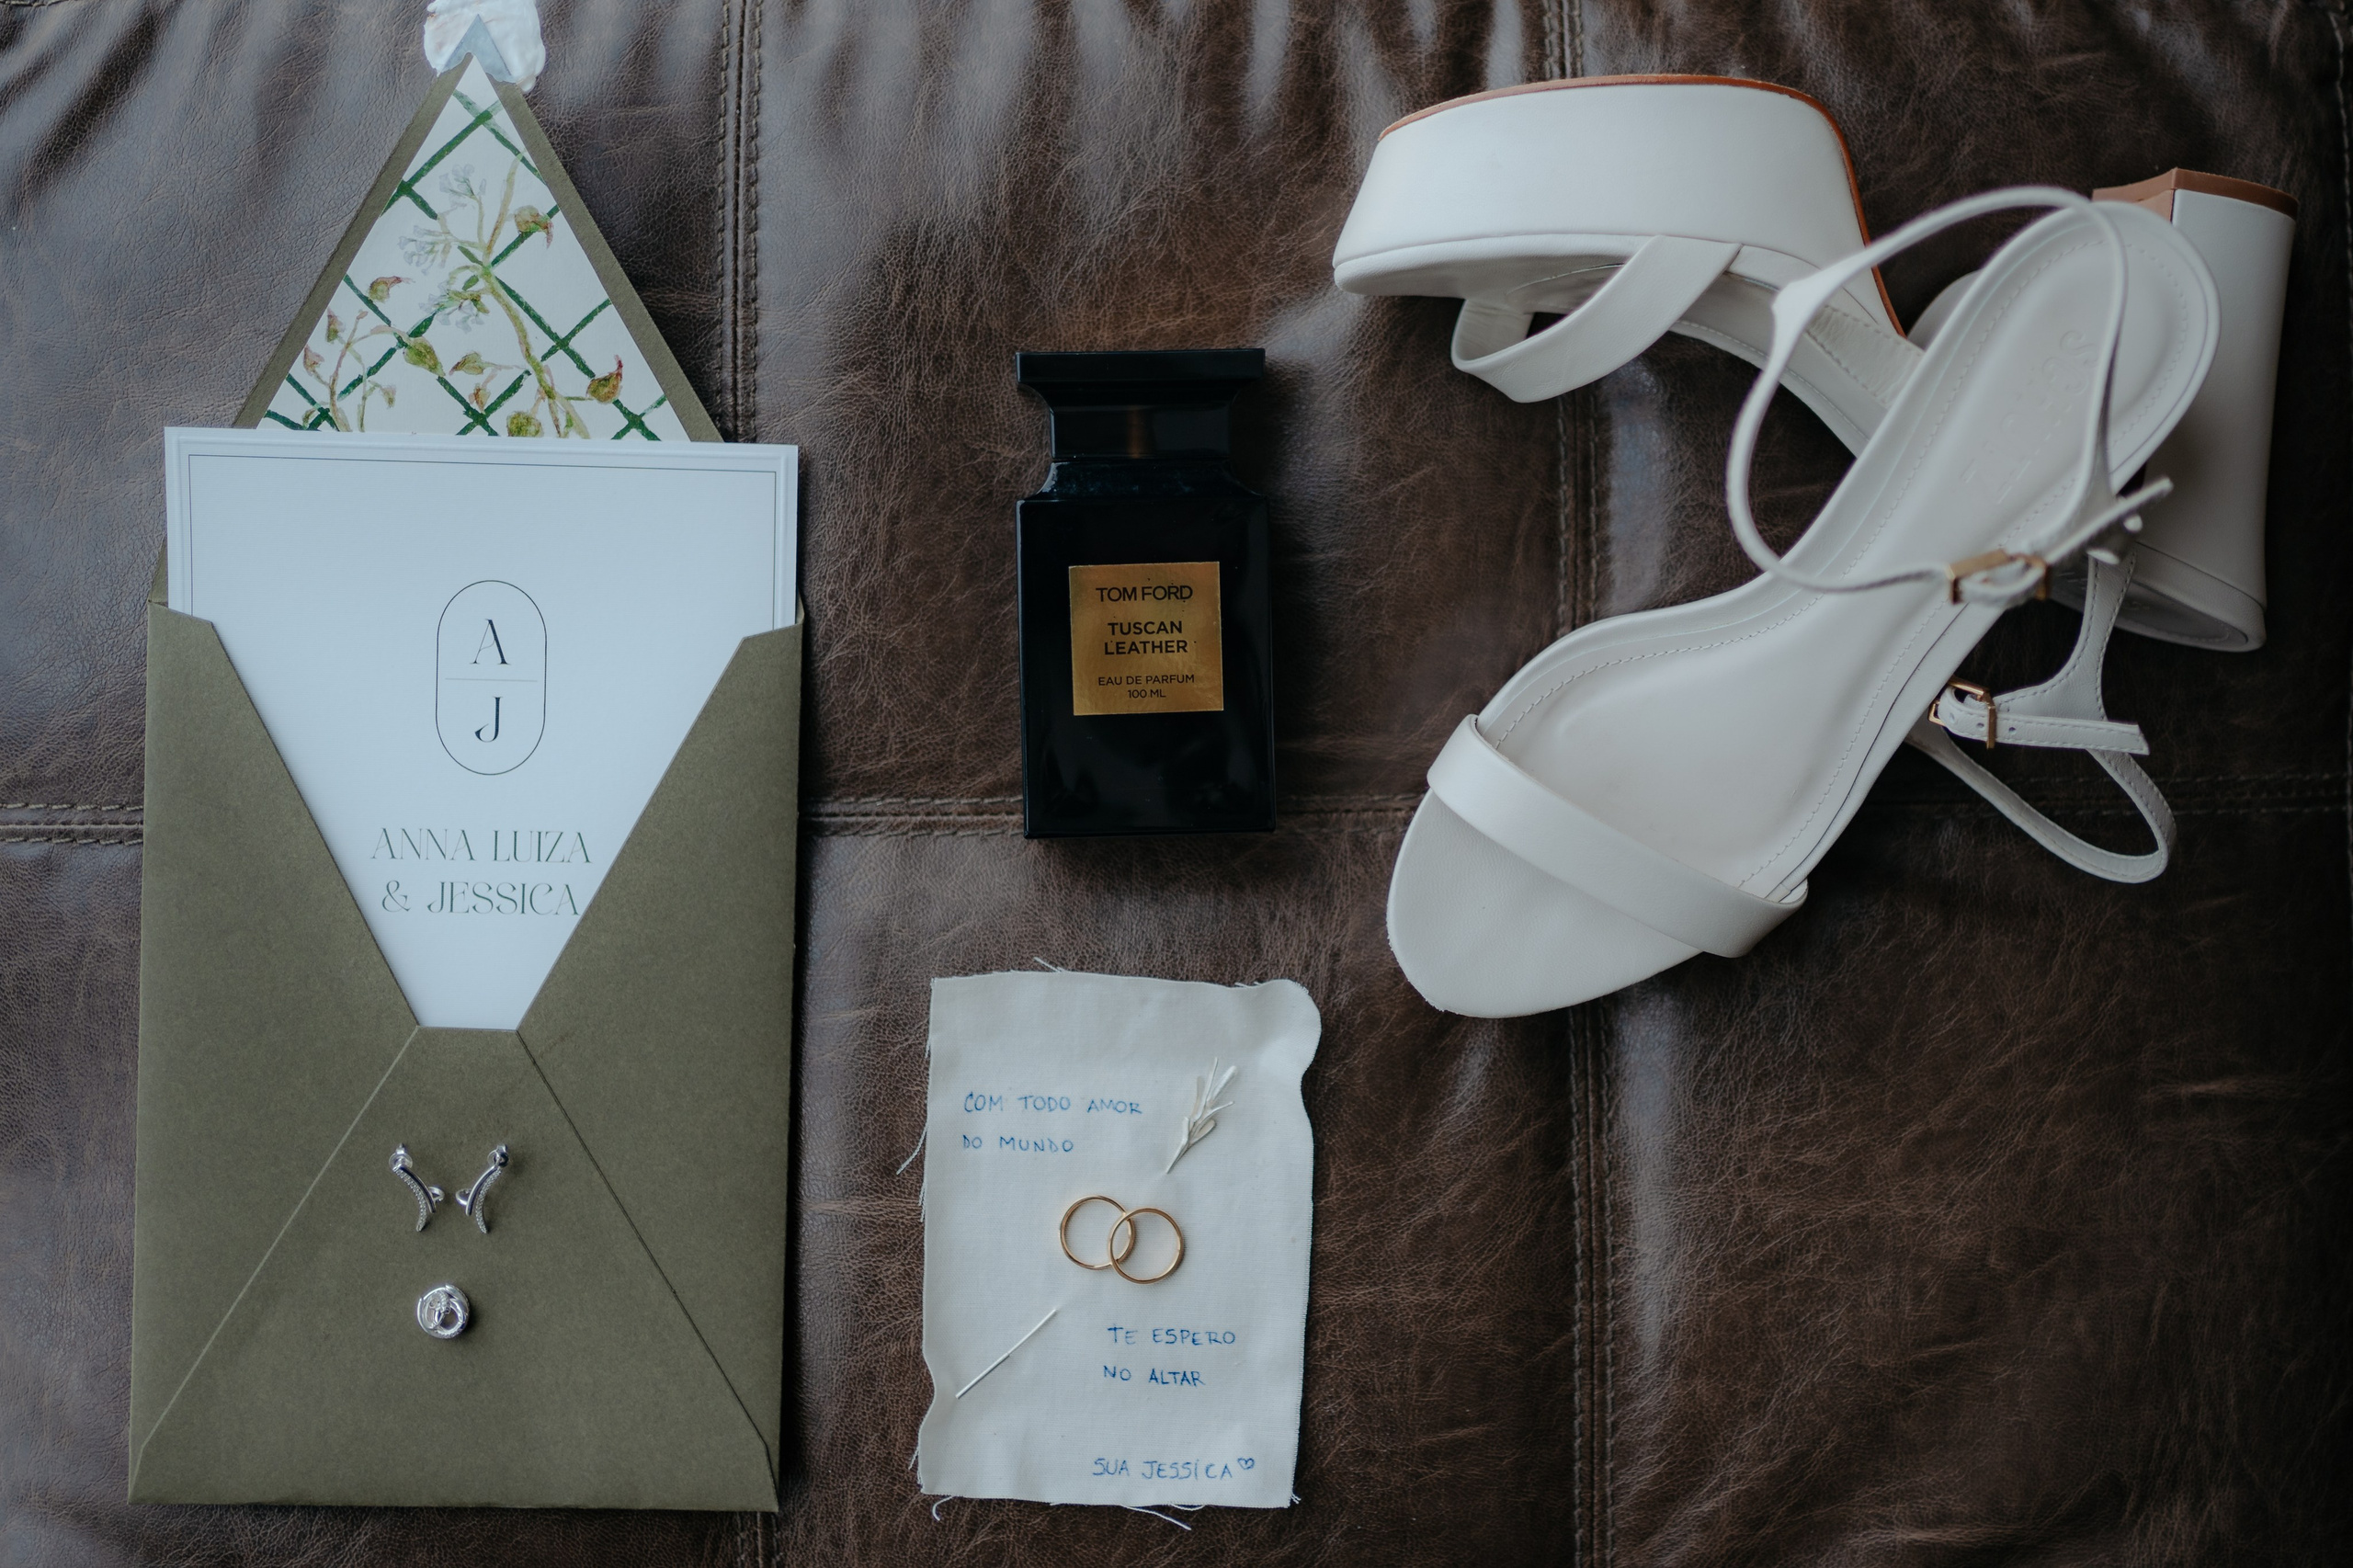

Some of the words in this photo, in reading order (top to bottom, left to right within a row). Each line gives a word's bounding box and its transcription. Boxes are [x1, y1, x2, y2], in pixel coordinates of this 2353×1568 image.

[1096, 586, 1137, 602] TOM
[1142, 585, 1193, 600] FORD
[1108, 620, 1182, 635] TUSCAN
[470, 619, 511, 665] A
[1105, 640, 1188, 655] LEATHER
[1098, 676, 1122, 687] EAU
[1126, 676, 1142, 685] DE
[1146, 674, 1195, 684] PARFUM
[1128, 690, 1147, 699] 100
[1150, 689, 1166, 698] ML
[474, 696, 503, 743] J
[370, 827, 477, 861] ANNA
[492, 830, 593, 864] LUIZA
[381, 880, 411, 913] &
[426, 881, 582, 916] JESSICA
[964, 1091, 1004, 1112] COM
[1017, 1095, 1071, 1112] TODO
[1087, 1099, 1142, 1115] AMOR
[962, 1134, 983, 1149] DO
[1000, 1136, 1074, 1153] MUNDO
[1107, 1324, 1139, 1345] TE
[1153, 1328, 1236, 1346] ESPERO
[1103, 1365, 1131, 1381] NO
[1148, 1369, 1206, 1386] ALTAR
[1092, 1458, 1130, 1476] SUA
[1142, 1460, 1233, 1480] JESSICA
